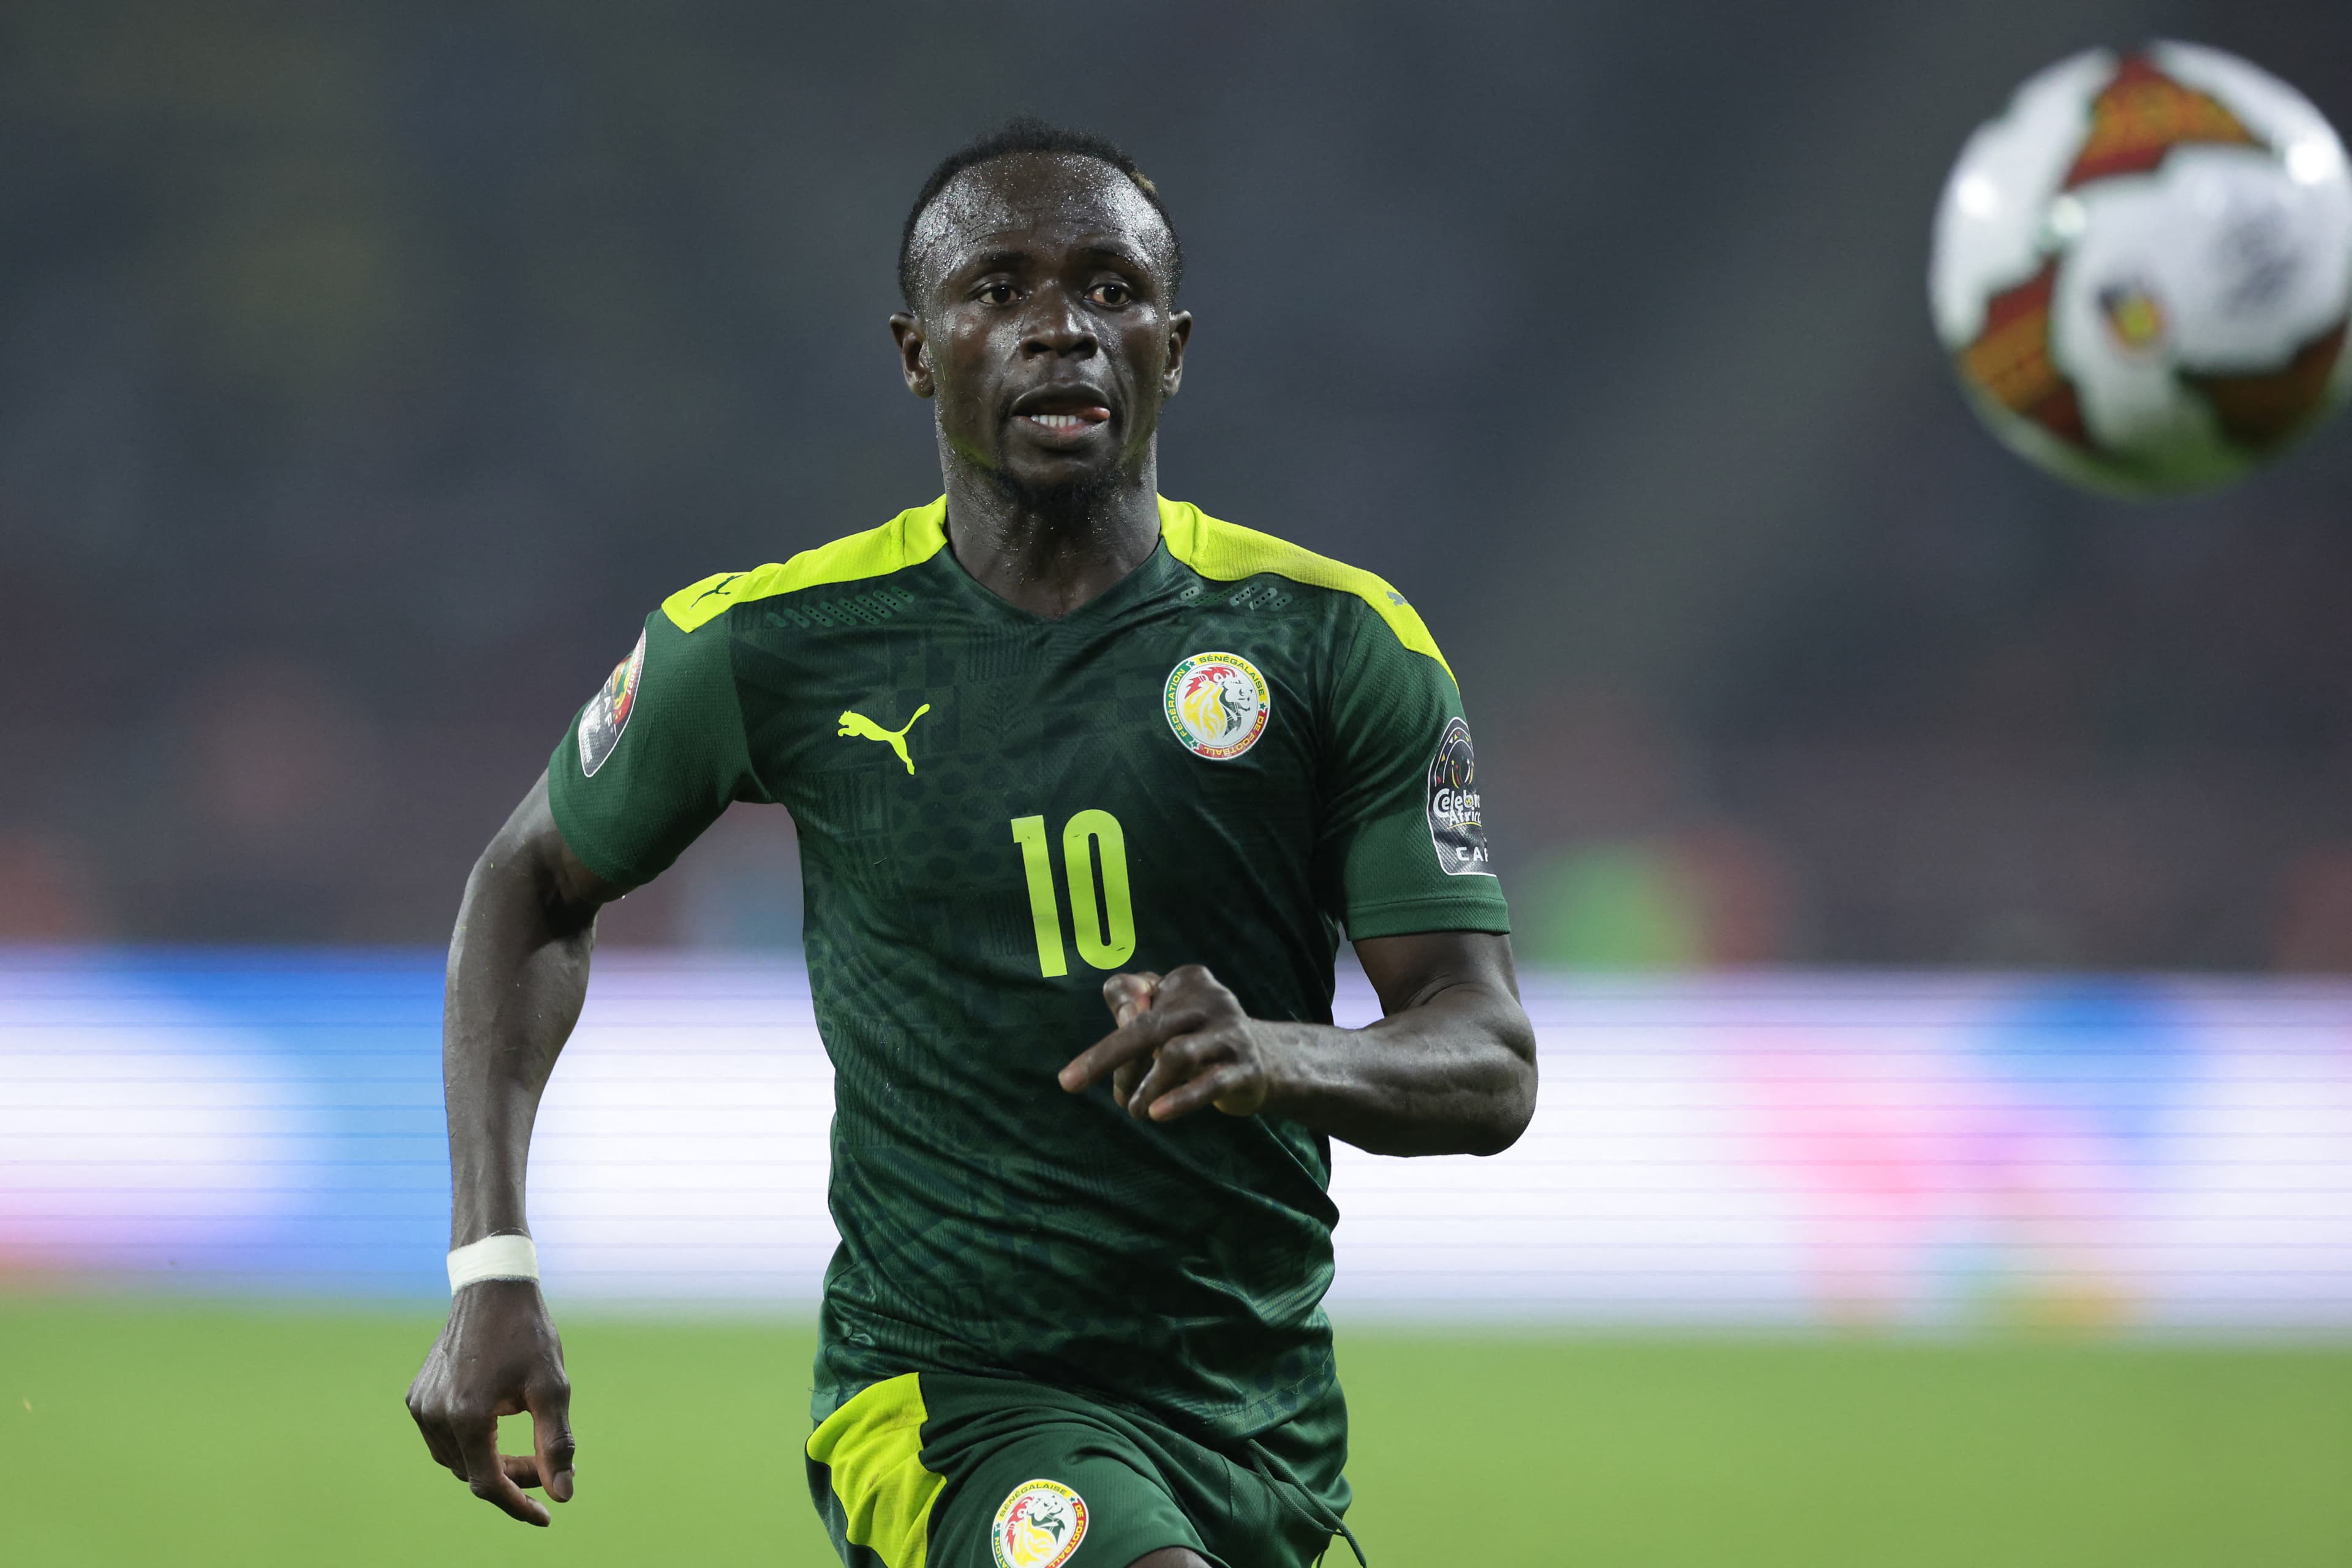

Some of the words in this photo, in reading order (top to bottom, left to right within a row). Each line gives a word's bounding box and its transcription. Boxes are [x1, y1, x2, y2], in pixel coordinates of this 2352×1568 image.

[1199, 654, 1265, 696] SÉNÉGALAISE
[1167, 668, 1187, 737] FÉDÉRATION
[1254, 715, 1264, 732] DE
[1204, 733, 1256, 758] FOOTBALL
[1433, 788, 1481, 818] Celebr
[1011, 809, 1136, 978] 10
[999, 1483, 1068, 1518] SÉNÉGALAISE
[1074, 1504, 1084, 1518] DE
[994, 1537, 1009, 1568] ATION
[1049, 1520, 1084, 1568] FOOTBALL
